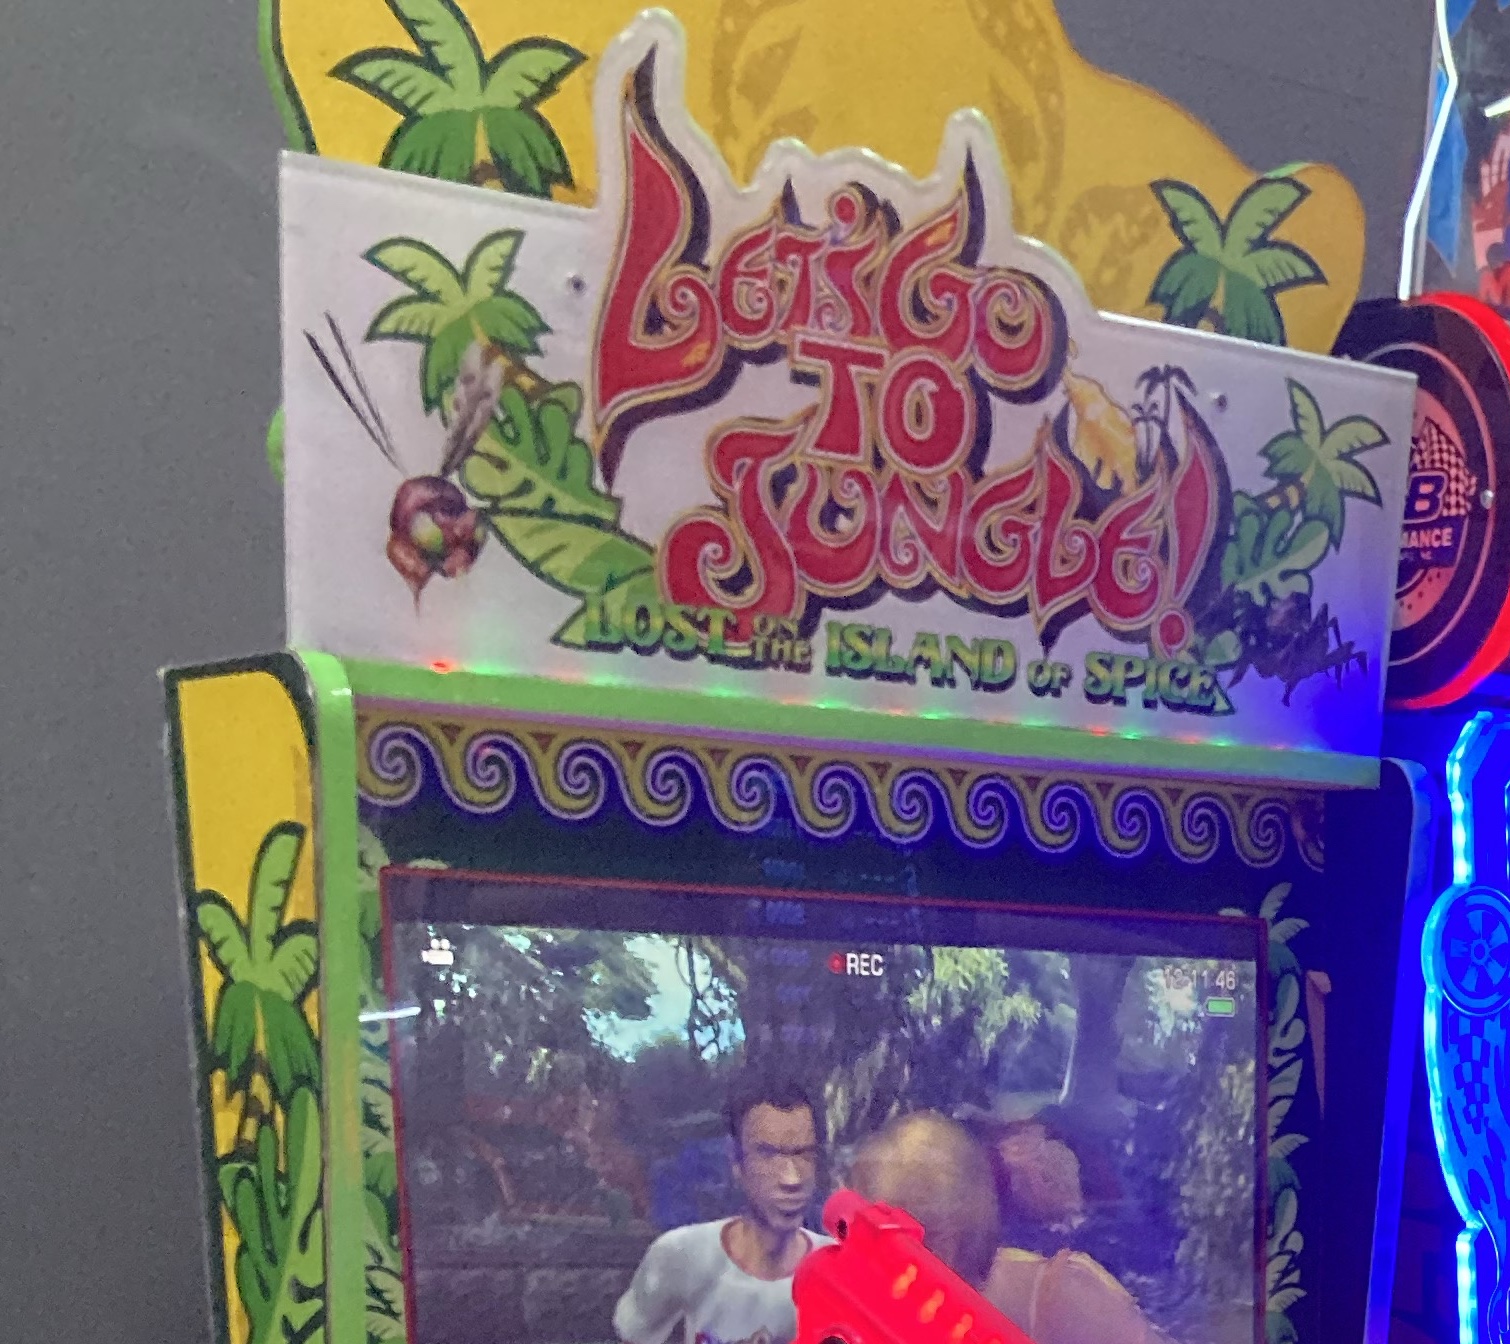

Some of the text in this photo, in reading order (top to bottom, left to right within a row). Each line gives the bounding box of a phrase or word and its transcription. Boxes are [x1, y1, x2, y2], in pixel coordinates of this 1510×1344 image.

[878, 172, 1064, 384] GO
[793, 338, 976, 478] TO
[658, 398, 1222, 662] JUNGLE!
[583, 596, 737, 657] LOST
[825, 621, 1018, 691] ISLAND
[1028, 659, 1074, 696] OF
[1083, 651, 1219, 713] SPICE
[846, 952, 884, 976] REC
